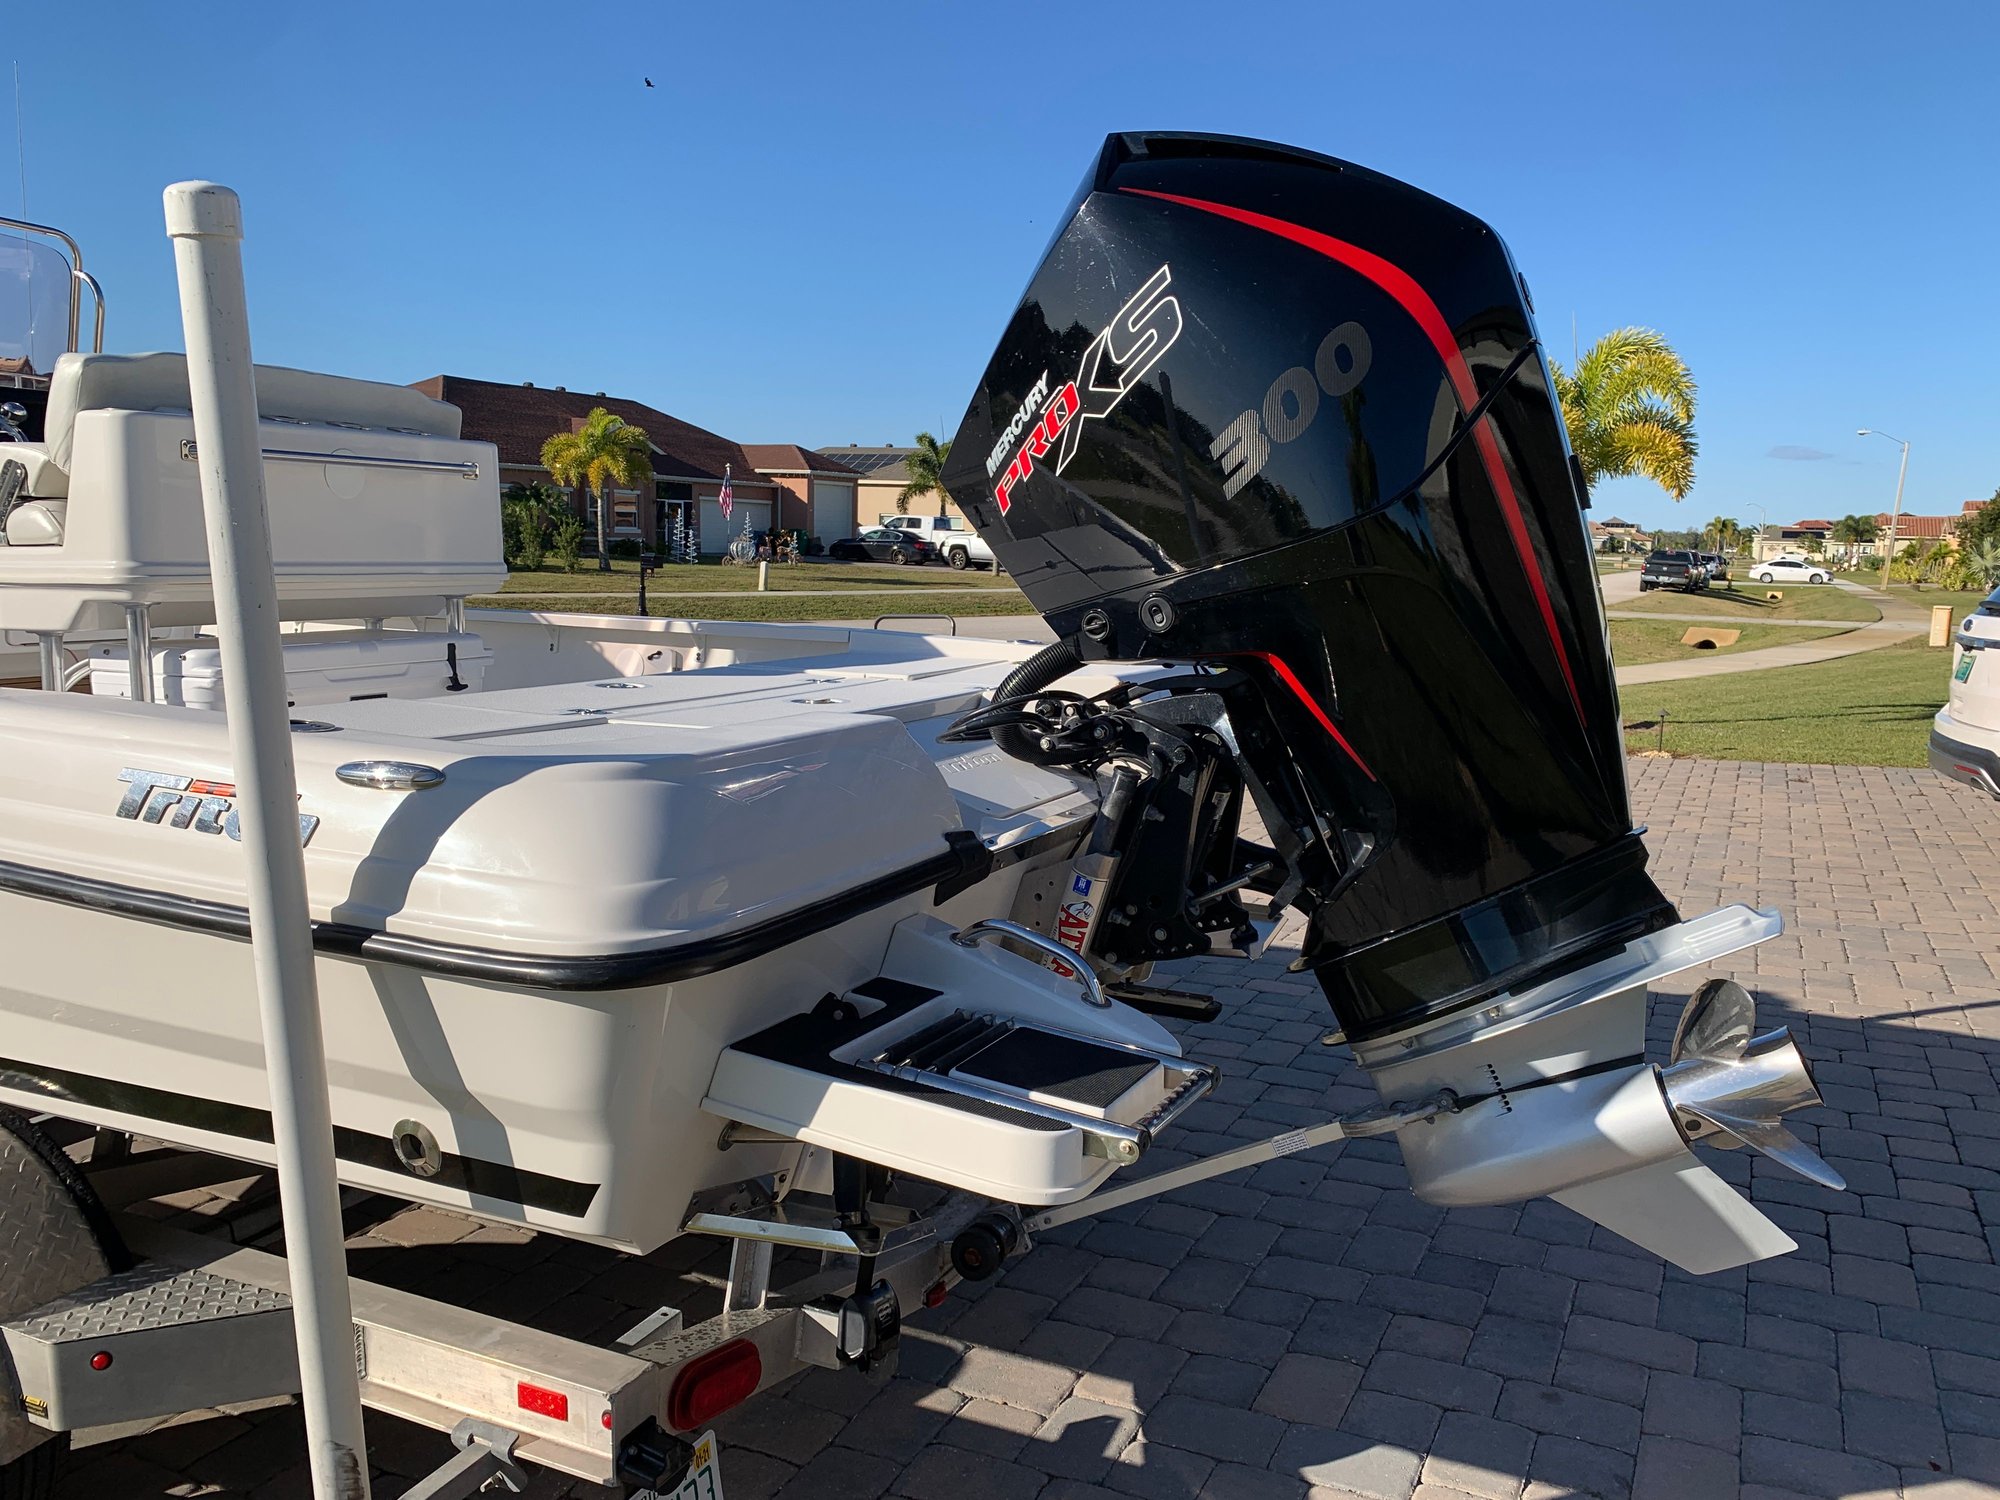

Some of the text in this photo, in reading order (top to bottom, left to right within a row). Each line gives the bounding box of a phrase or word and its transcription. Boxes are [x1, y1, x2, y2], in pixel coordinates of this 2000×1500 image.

[985, 369, 1049, 479] MERCURY
[994, 263, 1183, 517] PRO XS
[1209, 321, 1372, 500] 300
